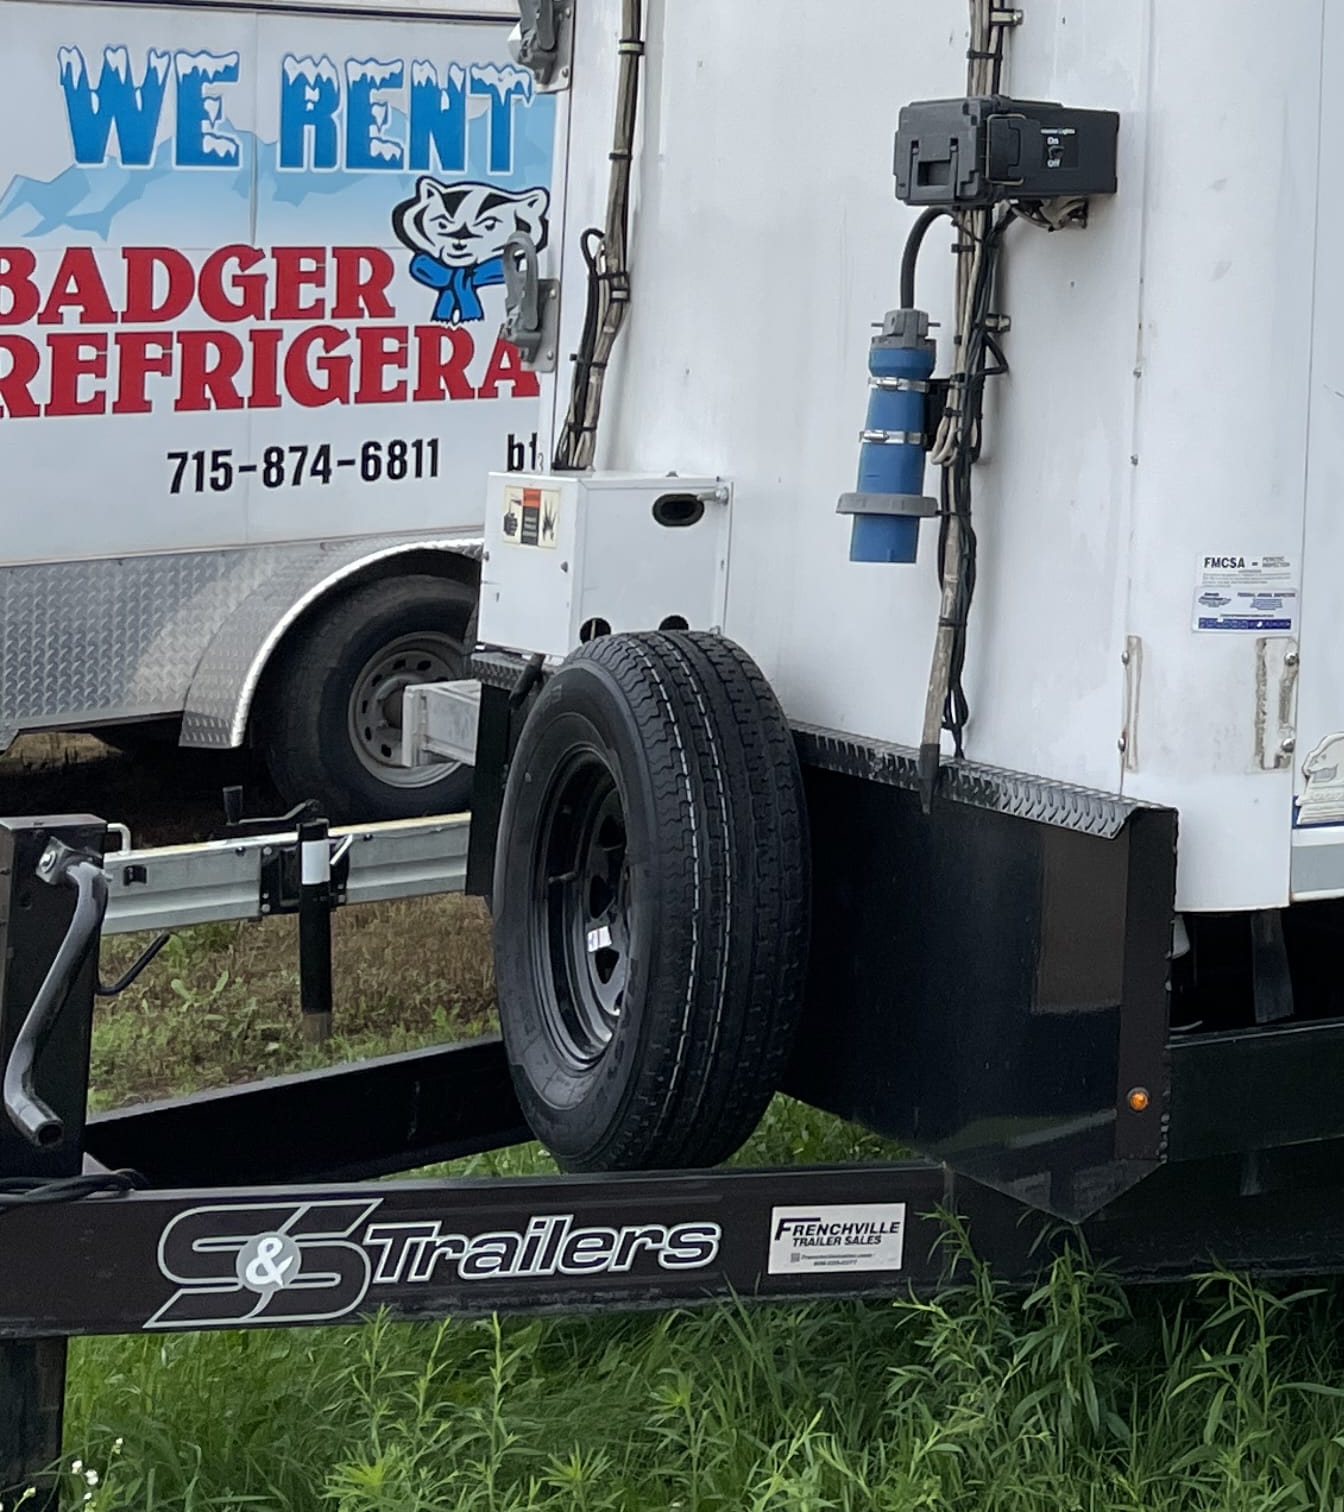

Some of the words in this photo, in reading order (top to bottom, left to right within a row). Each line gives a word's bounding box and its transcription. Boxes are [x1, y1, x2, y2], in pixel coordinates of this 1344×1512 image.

[57, 44, 241, 167] WE
[276, 52, 534, 174] RENT
[167, 437, 440, 494] 715-874-6811
[1204, 557, 1245, 568] FMCSA
[364, 1214, 722, 1284] Trailers
[775, 1217, 901, 1241] FRENCHVILLE
[793, 1236, 842, 1248] TRAILER
[844, 1235, 882, 1246] SALES
